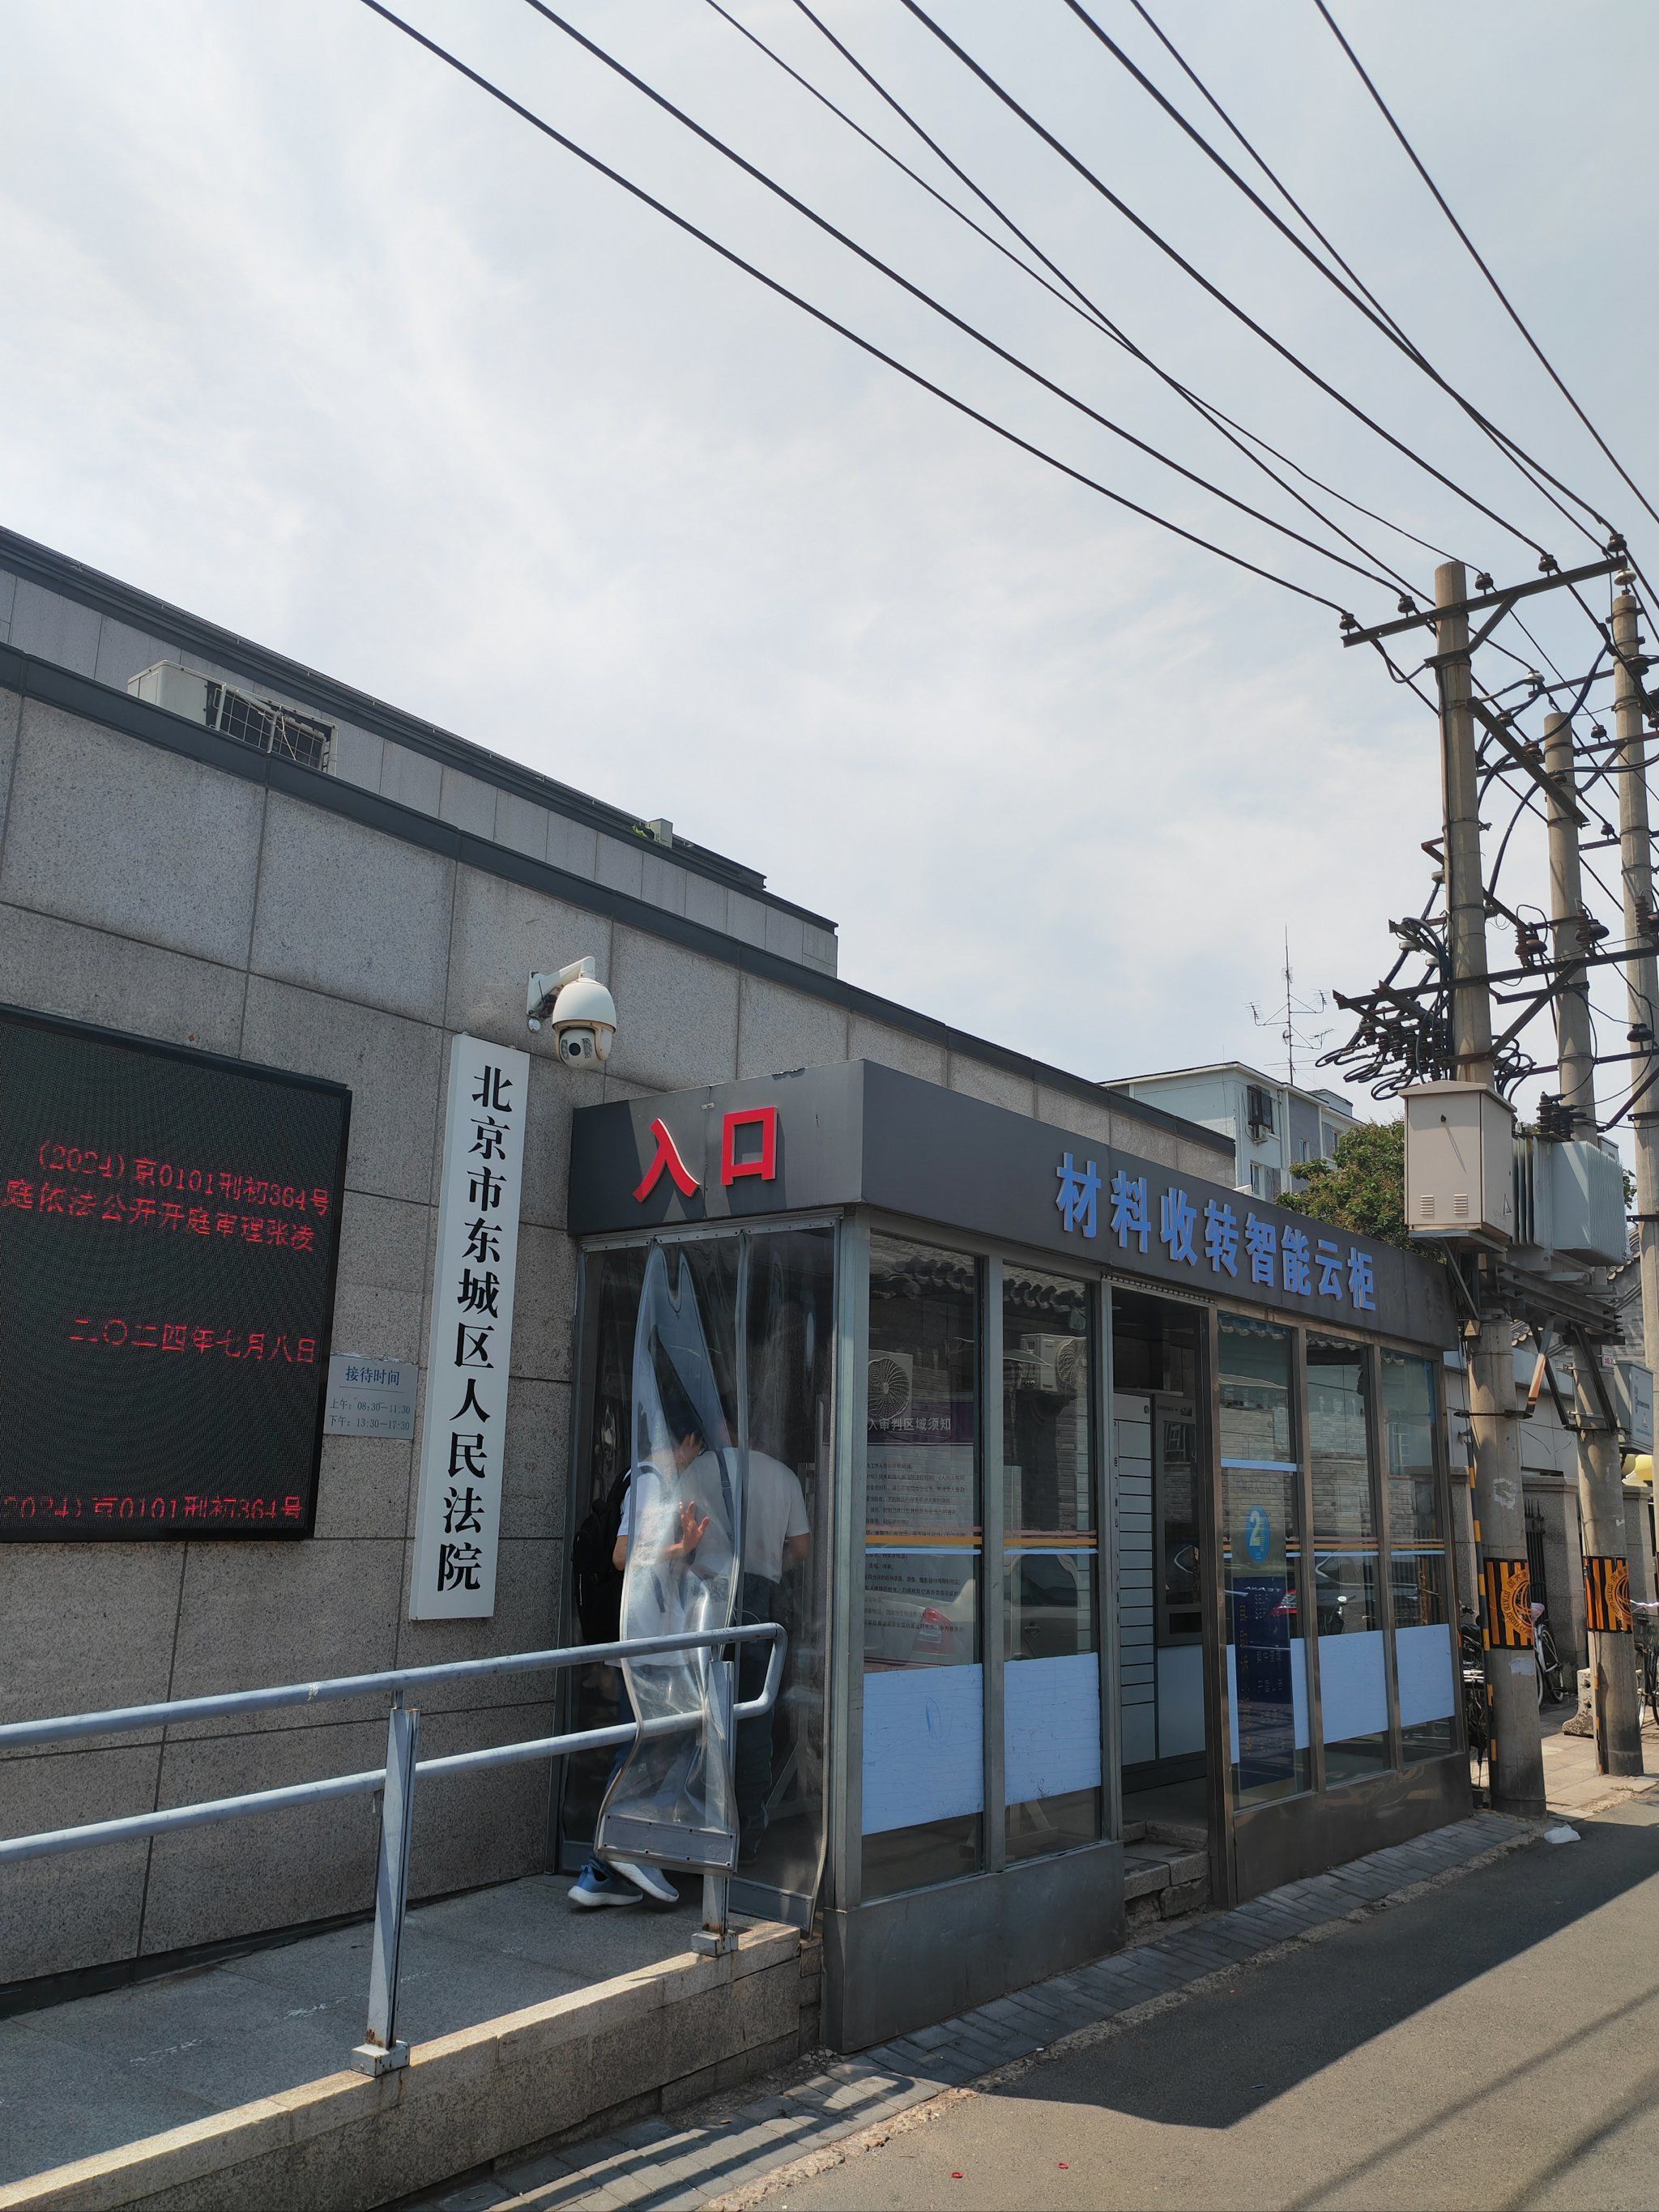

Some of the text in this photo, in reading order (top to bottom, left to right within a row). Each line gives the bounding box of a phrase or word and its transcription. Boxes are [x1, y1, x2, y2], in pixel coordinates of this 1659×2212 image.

[632, 1106, 778, 1203] 入口
[1056, 1153, 1376, 1310] 材料收转智能云柜
[437, 1064, 513, 1592] 北京市东城区人民法院
[346, 1366, 400, 1386] 接待时间
[1503, 1589, 1512, 1611] STATE
[1507, 1612, 1520, 1627] GRID
